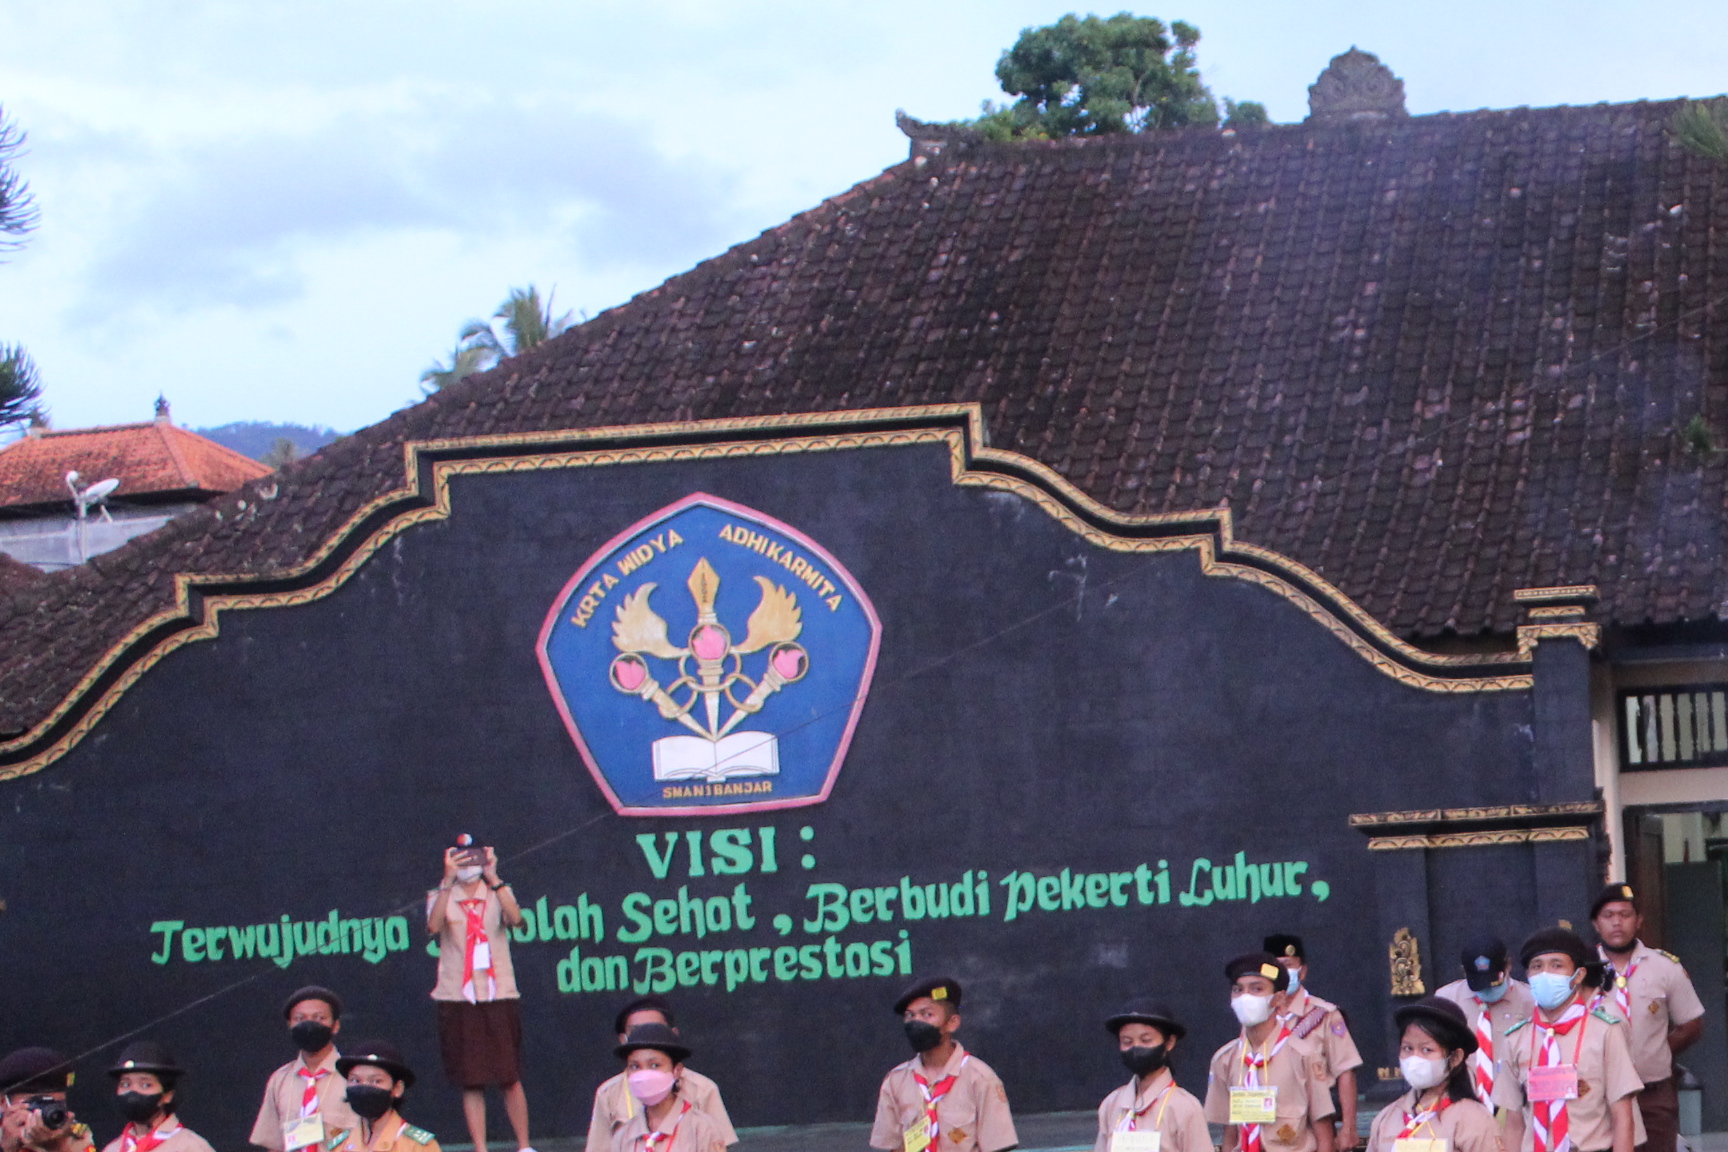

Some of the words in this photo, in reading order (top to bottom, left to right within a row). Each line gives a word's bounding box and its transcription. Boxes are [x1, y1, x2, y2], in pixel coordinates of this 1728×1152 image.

[571, 573, 620, 629] KRTA
[617, 529, 684, 576] WIDYA
[719, 524, 844, 612] ADHIKARMITA
[636, 826, 778, 879] VISI
[149, 909, 410, 969] Terwujudnya
[803, 868, 991, 934] Berbudi
[1000, 858, 1171, 922] Pekerti
[556, 946, 629, 993] dan
[633, 930, 912, 995] Berprestasi
